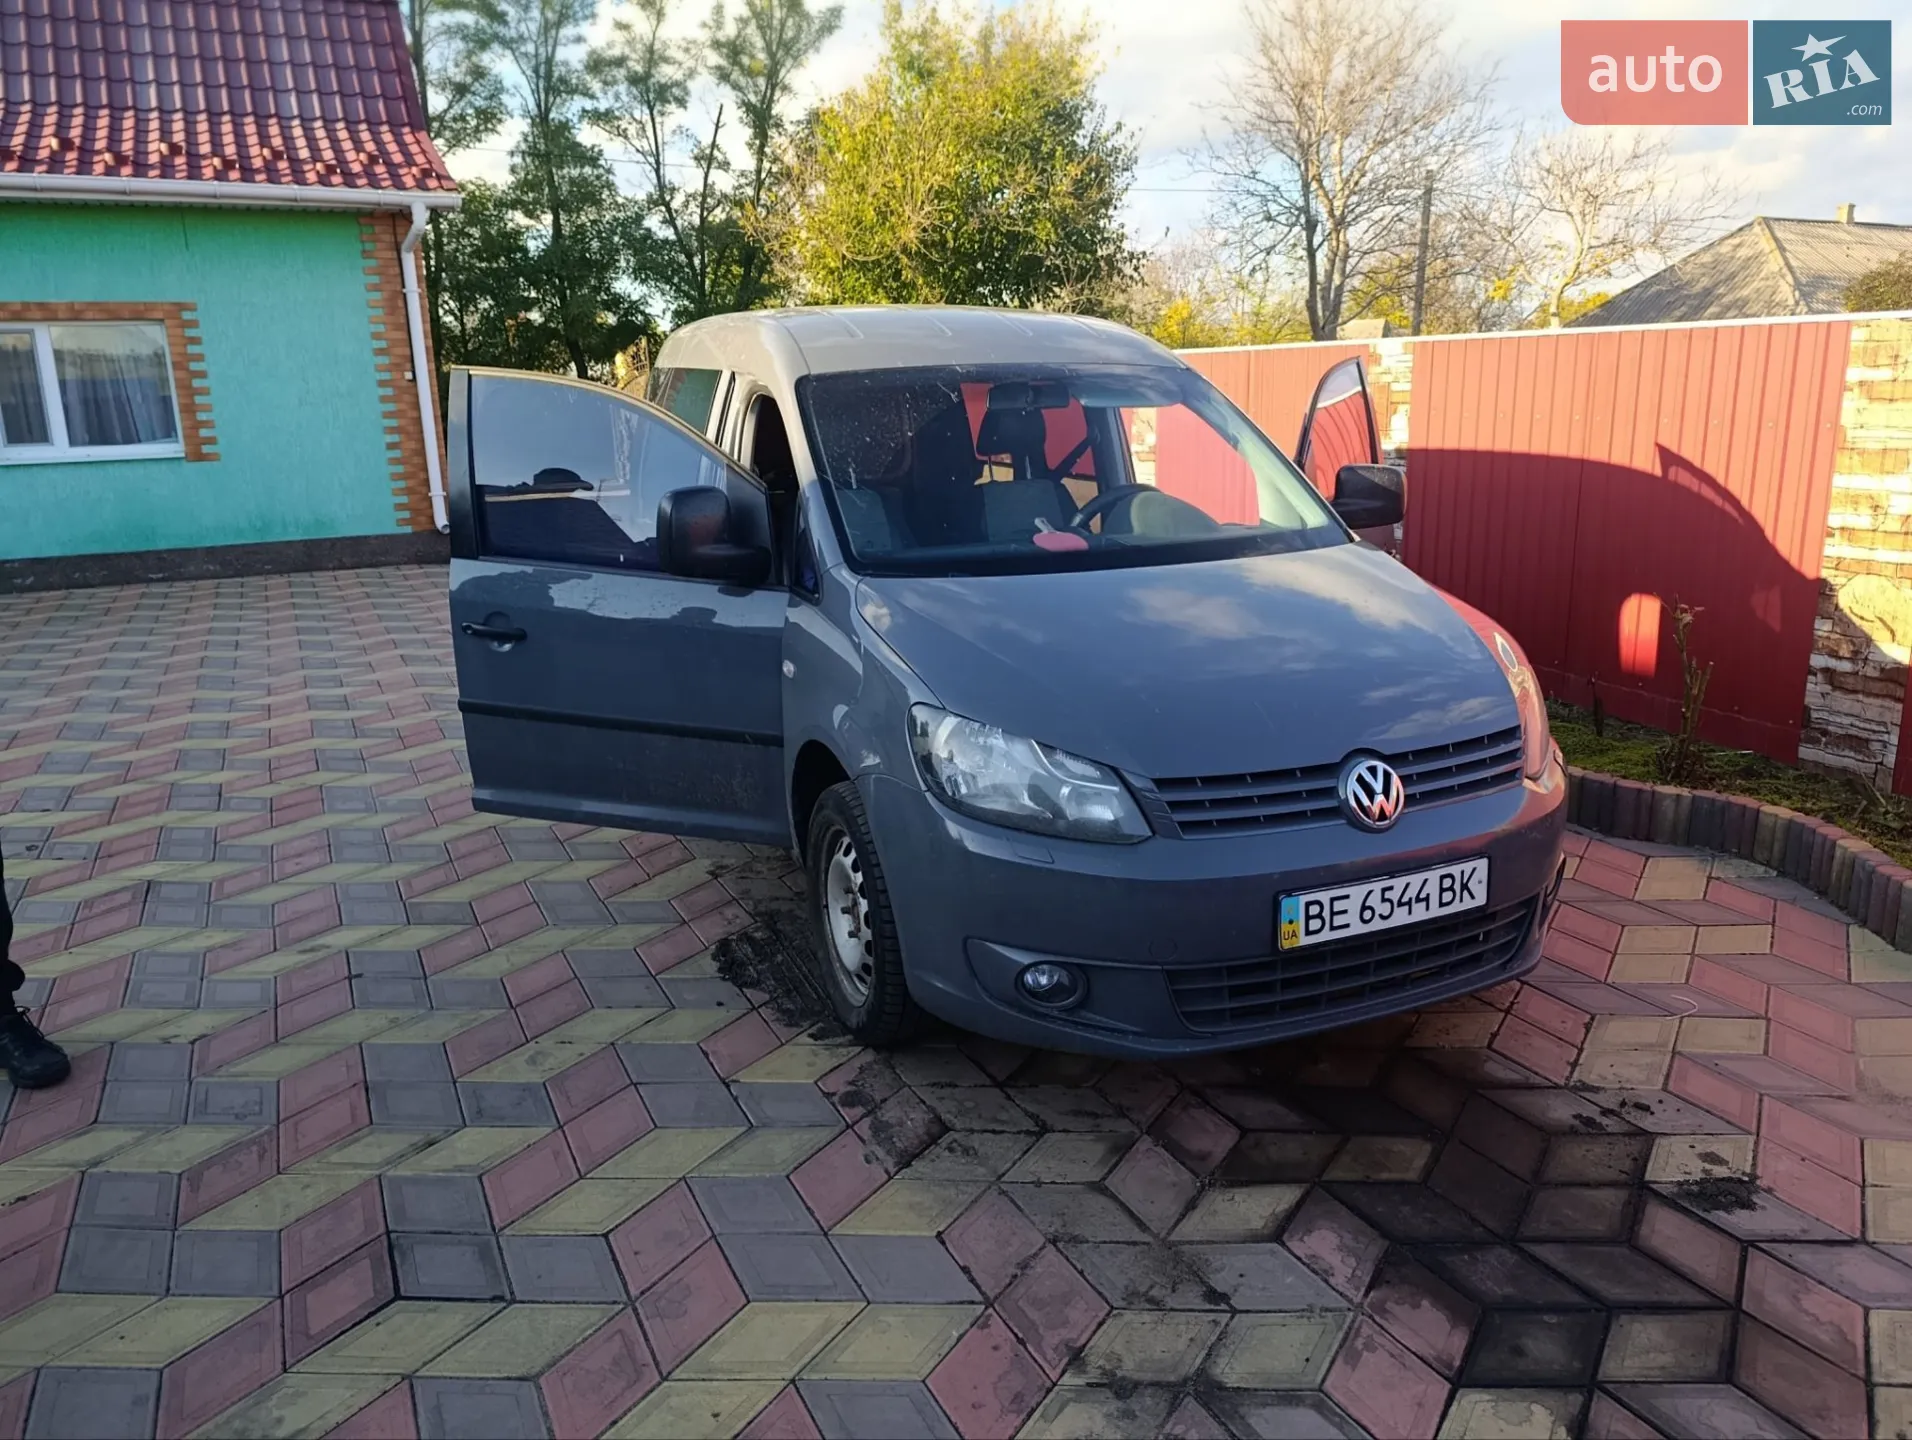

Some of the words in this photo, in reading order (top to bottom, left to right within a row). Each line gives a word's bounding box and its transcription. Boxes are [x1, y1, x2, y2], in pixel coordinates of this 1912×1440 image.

[1304, 894, 1351, 937] BE
[1359, 877, 1431, 925] 6544
[1438, 866, 1478, 909] BK
[1282, 929, 1298, 941] UA
